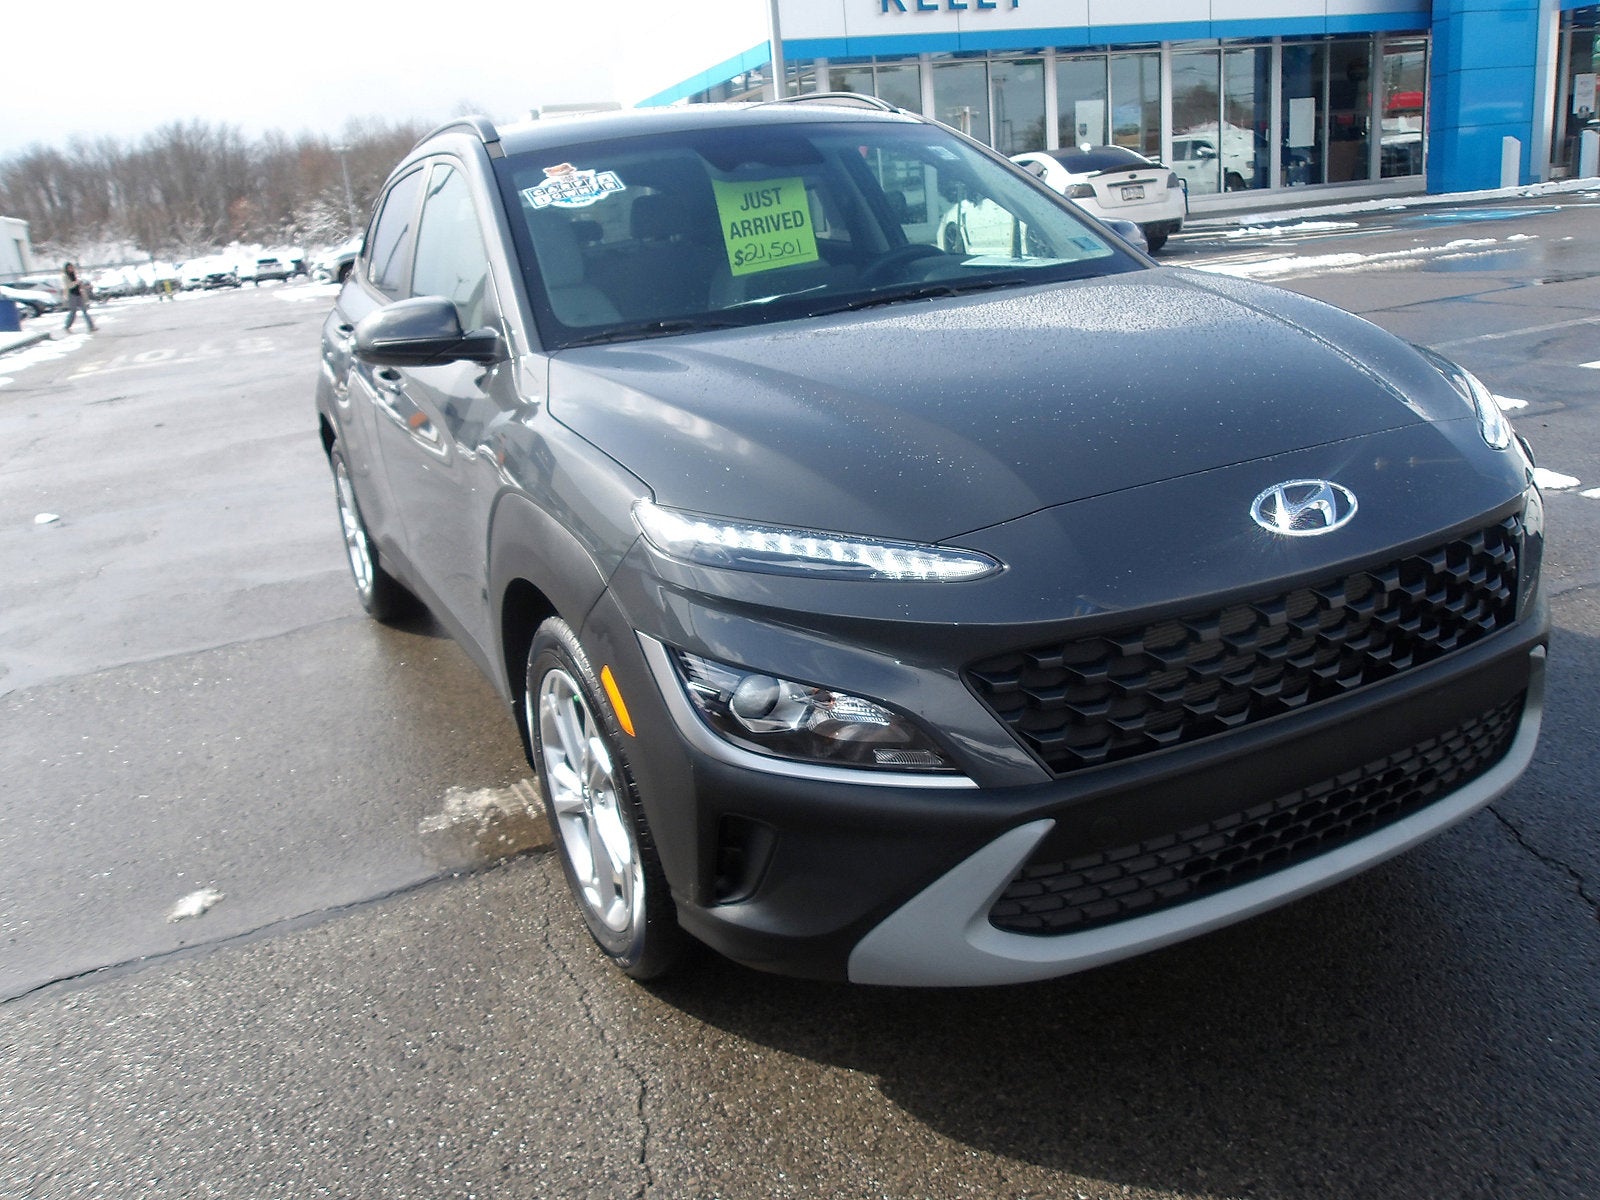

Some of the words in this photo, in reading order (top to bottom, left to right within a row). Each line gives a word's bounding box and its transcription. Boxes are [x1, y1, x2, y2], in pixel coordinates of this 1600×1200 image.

[740, 187, 782, 211] JUST
[730, 210, 805, 240] ARRIVED
[735, 238, 802, 267] $21,501
